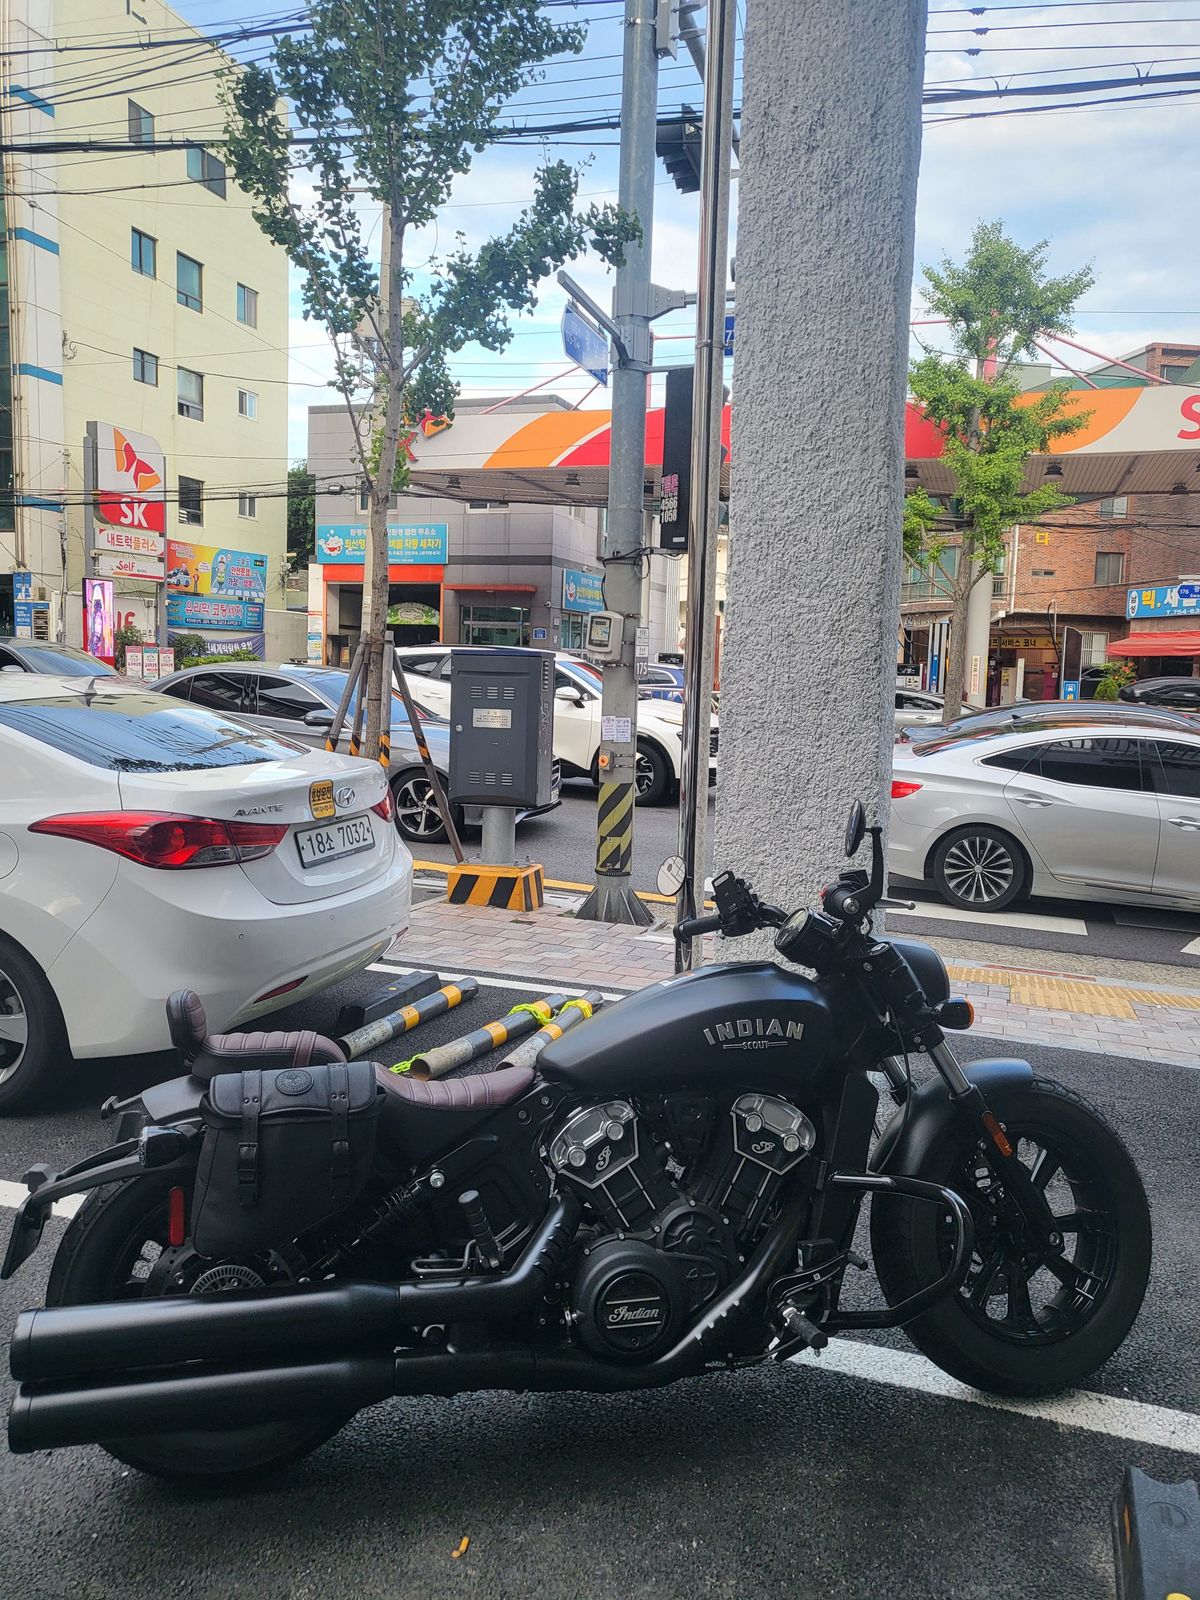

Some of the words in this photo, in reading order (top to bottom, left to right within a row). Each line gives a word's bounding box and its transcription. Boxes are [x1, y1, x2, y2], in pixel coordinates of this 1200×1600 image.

[120, 497, 148, 528] SK
[106, 533, 158, 552] 내트럭플러스
[419, 538, 442, 550] 세차기
[118, 560, 136, 572] Self
[1001, 638, 1020, 648] 서비스
[1023, 638, 1037, 648] 코너
[636, 662, 648, 675] 175
[311, 785, 332, 803] 초보운전
[232, 803, 285, 817] AVANTE
[307, 831, 335, 856] 18소
[336, 821, 368, 847] 7032
[703, 1018, 805, 1046] INDIAN
[742, 1040, 769, 1050] SCOUT
[608, 1305, 660, 1323] Indian
